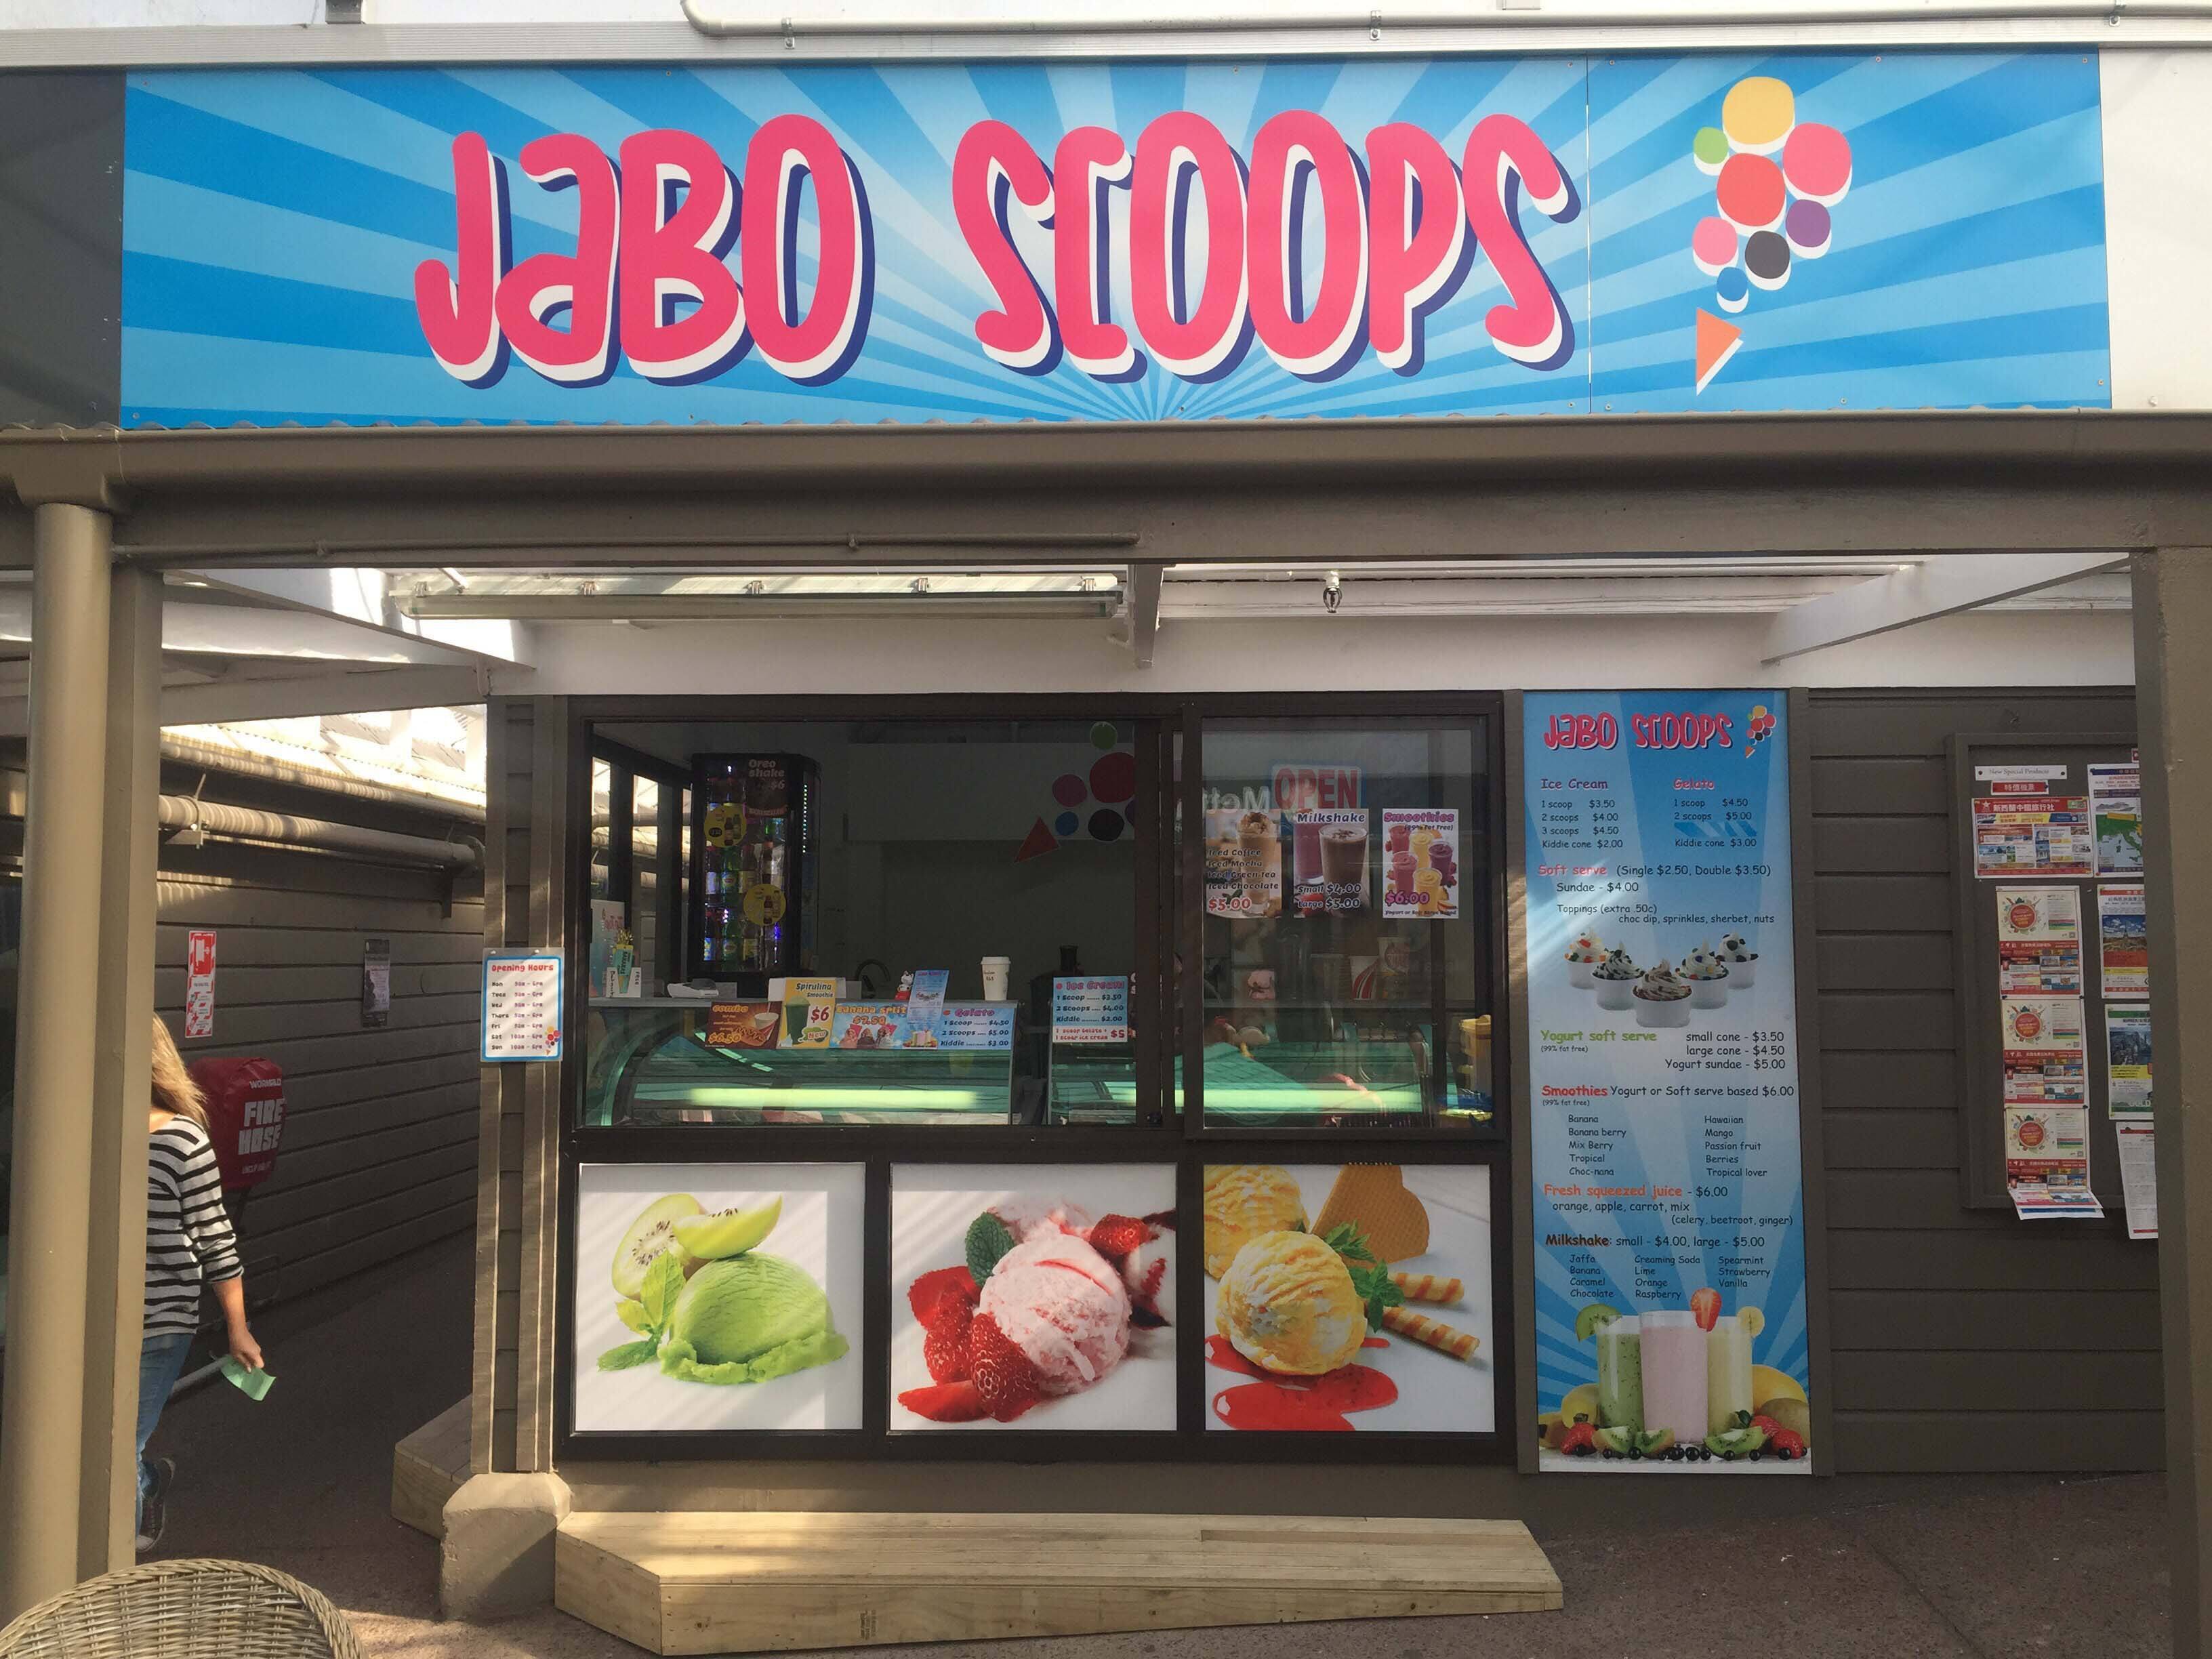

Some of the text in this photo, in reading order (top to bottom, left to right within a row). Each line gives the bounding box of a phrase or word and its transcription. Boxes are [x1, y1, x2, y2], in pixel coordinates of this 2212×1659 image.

[952, 109, 1581, 384] SCOOPS
[1631, 712, 1734, 750] SCOOPS
[748, 759, 776, 768] Oreo
[748, 769, 785, 777] shake
[1274, 768, 1358, 809] OPEN
[1541, 779, 1608, 790] Ice Cream
[1673, 778, 1715, 790] Gelato
[1548, 801, 1572, 809] scoop
[1589, 799, 1615, 808] $3.50
[1680, 800, 1705, 808] scoop
[1723, 798, 1748, 807] $4.50
[1298, 813, 1365, 823] Milkshake
[1384, 811, 1454, 822] Smoothies
[1549, 815, 1579, 823] scoops
[1593, 813, 1618, 821] $4.00
[1682, 813, 1712, 822] scoops
[1726, 811, 1752, 820] $5.00
[1550, 827, 1579, 836] scoops
[1593, 826, 1619, 835] $4.50
[1542, 840, 1569, 848] Kiddie
[1597, 840, 1623, 848] $2.00
[1675, 839, 1702, 847] Kiddie
[1730, 838, 1757, 847] $3.00
[1539, 864, 1771, 876] Soft serve (Single $2.50, Double $3.50)
[1231, 881, 1279, 890] Chocolate
[1298, 883, 1361, 895] Small $4.00
[1557, 882, 1639, 893] Sundae $4.00
[1385, 890, 1429, 905] $6.00
[1208, 897, 1252, 911] $5.00
[1326, 897, 1361, 909] $5.00
[1557, 905, 1597, 915] Toppings
[1600, 905, 1630, 914] (extra
[1618, 915, 1641, 923] choc
[1643, 915, 1660, 924] dip,
[1663, 915, 1708, 924] sprinkles,
[1711, 915, 1752, 924] sherbet,
[796, 983, 832, 992] Spirulina
[1067, 981, 1124, 990] Ice Cream
[811, 1006, 830, 1023] $6
[955, 1009, 995, 1017] Gelato
[808, 1031, 826, 1040] New
[1540, 1030, 1657, 1044] Yogurt soft serve
[1686, 1032, 1713, 1042] small
[1753, 1031, 1784, 1042] $3.50
[1686, 1046, 1713, 1057] large
[1753, 1045, 1784, 1056] $4.50
[1665, 1059, 1785, 1071] Yogurt sundae $5.00
[1542, 1086, 1607, 1097] Smoothies
[1611, 1086, 1647, 1098] Yogurt
[1666, 1086, 1691, 1096] Soft
[1727, 1086, 1758, 1096] based
[1762, 1086, 1794, 1097] $6.00
[243, 1098, 285, 1127] FIRE
[1568, 1115, 1598, 1123] Banana
[1704, 1115, 1743, 1124] Hawaiian
[1568, 1128, 1626, 1138] Banana berry
[1705, 1129, 1734, 1139] Mango
[238, 1126, 282, 1155] HOSE
[1569, 1141, 1613, 1151] Mix Berry
[1705, 1142, 1761, 1150] Passion fruit
[1570, 1154, 1604, 1164] Tropical
[1706, 1155, 1739, 1163] Berries
[1570, 1167, 1614, 1176] Choc-nana
[1706, 1168, 1742, 1178] Tropical
[1544, 1185, 1727, 1200] Fresh squeezed juice $6.00
[1553, 1202, 1689, 1212] orange, apple, carrot, mix
[1672, 1215, 1793, 1226] (celery, beetroot, ginger)
[1546, 1234, 1764, 1248] Milkshake: small $4.00, large $5.00
[1570, 1254, 1595, 1263] Jaffa
[1635, 1256, 1700, 1265] Creaming Soda
[1719, 1256, 1763, 1265] Spearmint
[1570, 1267, 1601, 1275] Banana
[1635, 1267, 1656, 1275] Lime
[1719, 1267, 1770, 1277] Strawberry
[1570, 1278, 1605, 1286] Caramel
[1635, 1279, 1667, 1288] Orange
[1719, 1279, 1748, 1288] Vanilla
[1570, 1290, 1614, 1298] Chocolate
[1636, 1290, 1681, 1300] Raspberry
